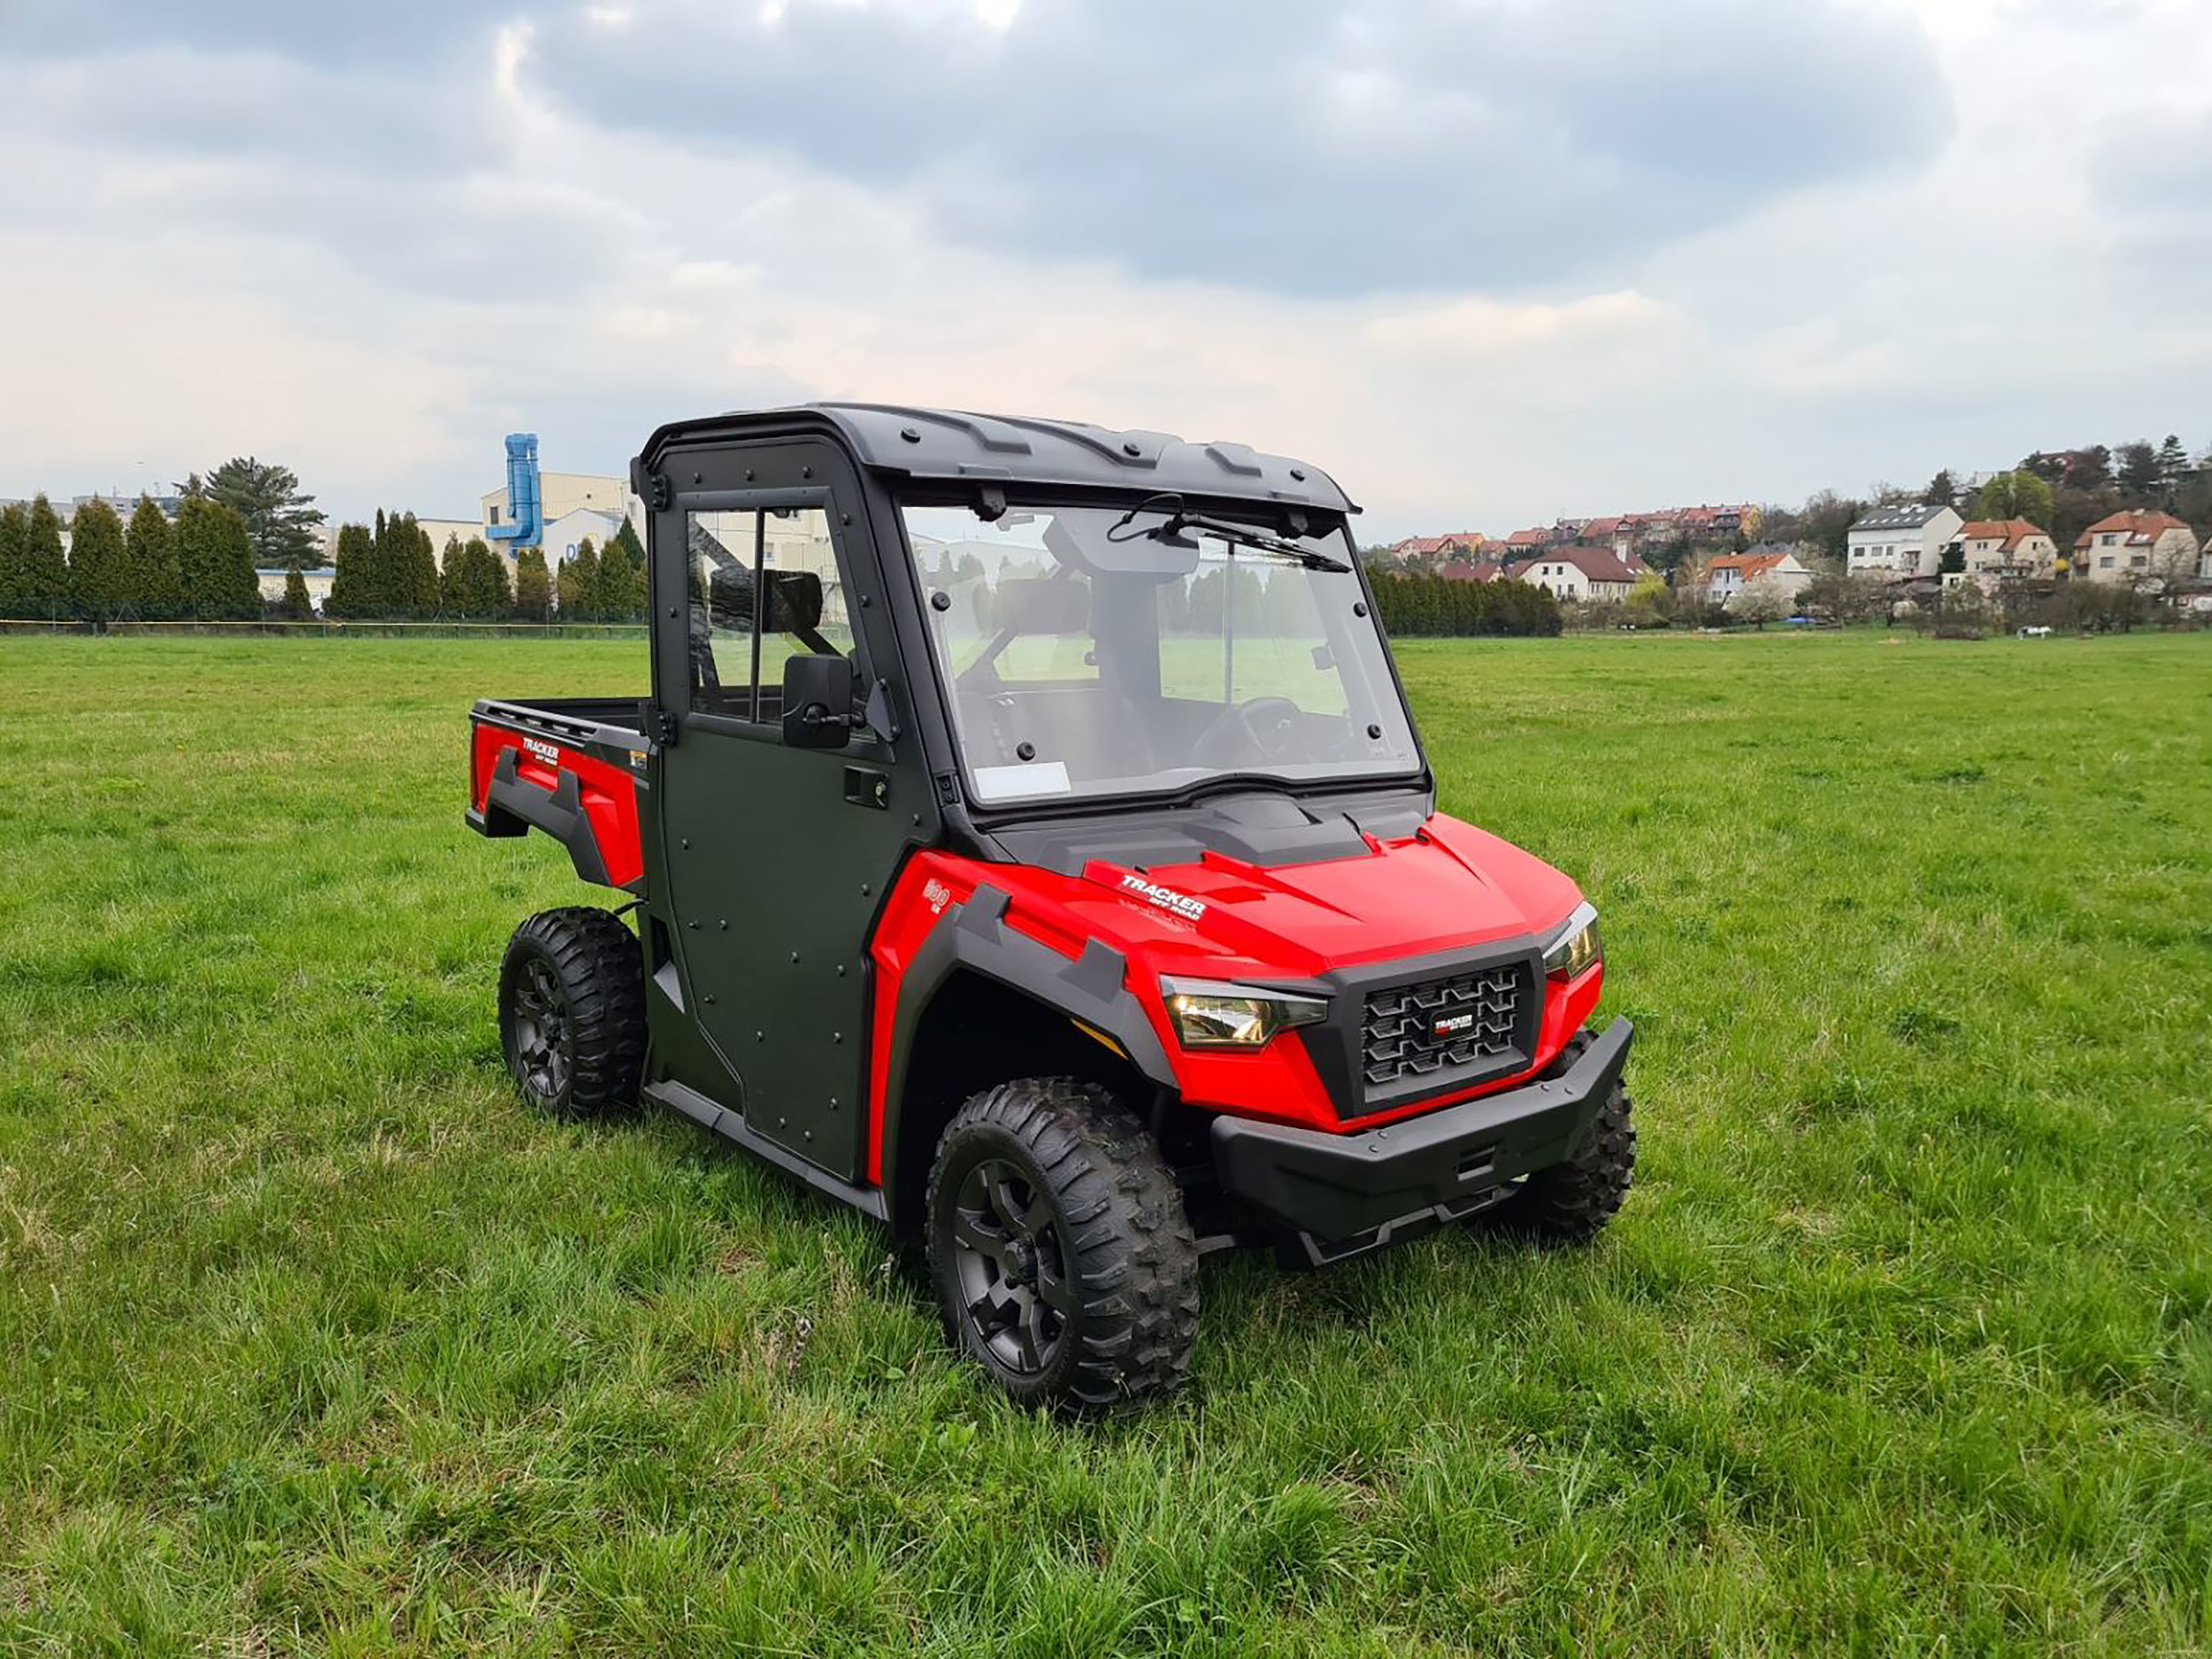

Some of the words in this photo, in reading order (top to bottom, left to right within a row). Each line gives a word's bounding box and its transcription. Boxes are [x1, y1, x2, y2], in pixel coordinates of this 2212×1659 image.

[523, 737, 559, 759] TRACKER
[1121, 874, 1207, 915] TRACKER
[1170, 905, 1202, 921] ROAD
[1435, 1014, 1473, 1029] TRACKER
